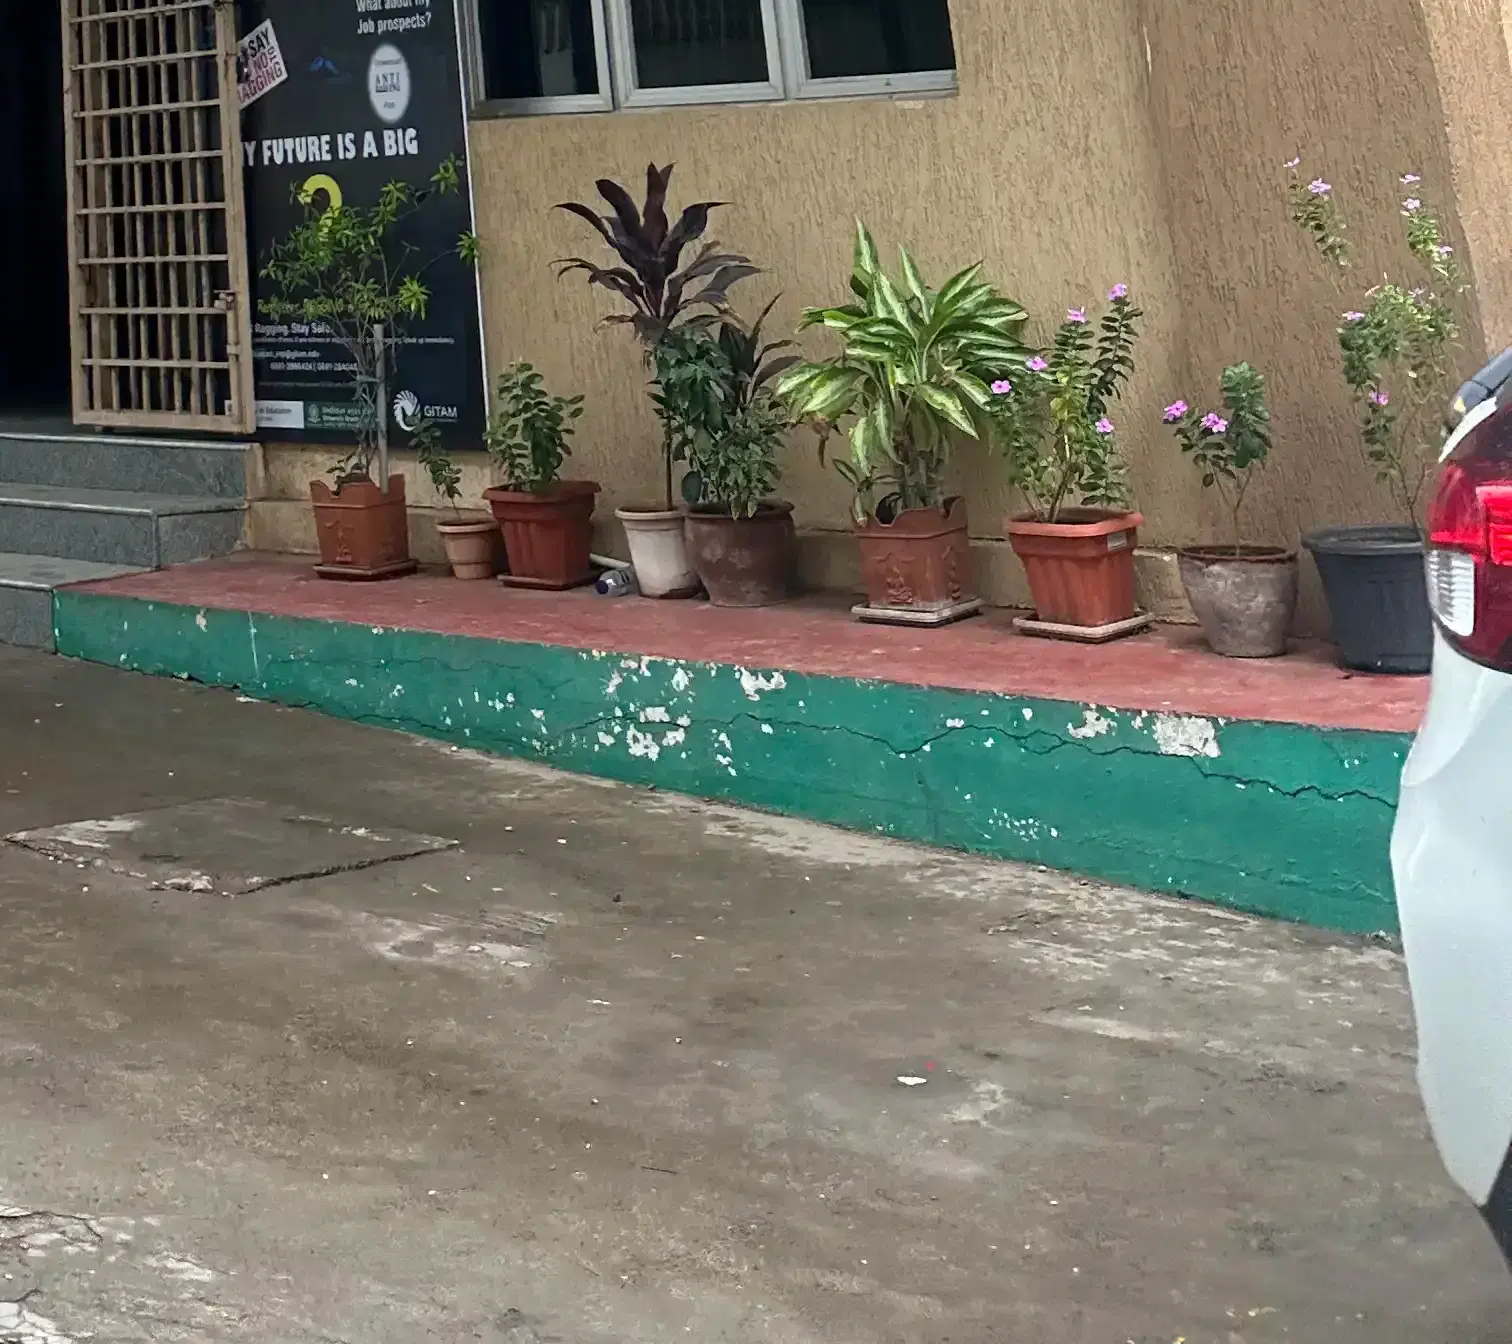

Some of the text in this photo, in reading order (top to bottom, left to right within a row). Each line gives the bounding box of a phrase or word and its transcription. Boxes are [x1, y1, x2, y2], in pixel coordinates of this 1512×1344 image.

[357, 11, 432, 35] Job prospects?
[248, 27, 271, 58] SAY
[253, 51, 269, 74] NO
[237, 62, 284, 104] AGGING
[242, 127, 419, 167] Y FUTURE IS A BIG
[424, 405, 458, 418] GITAM
